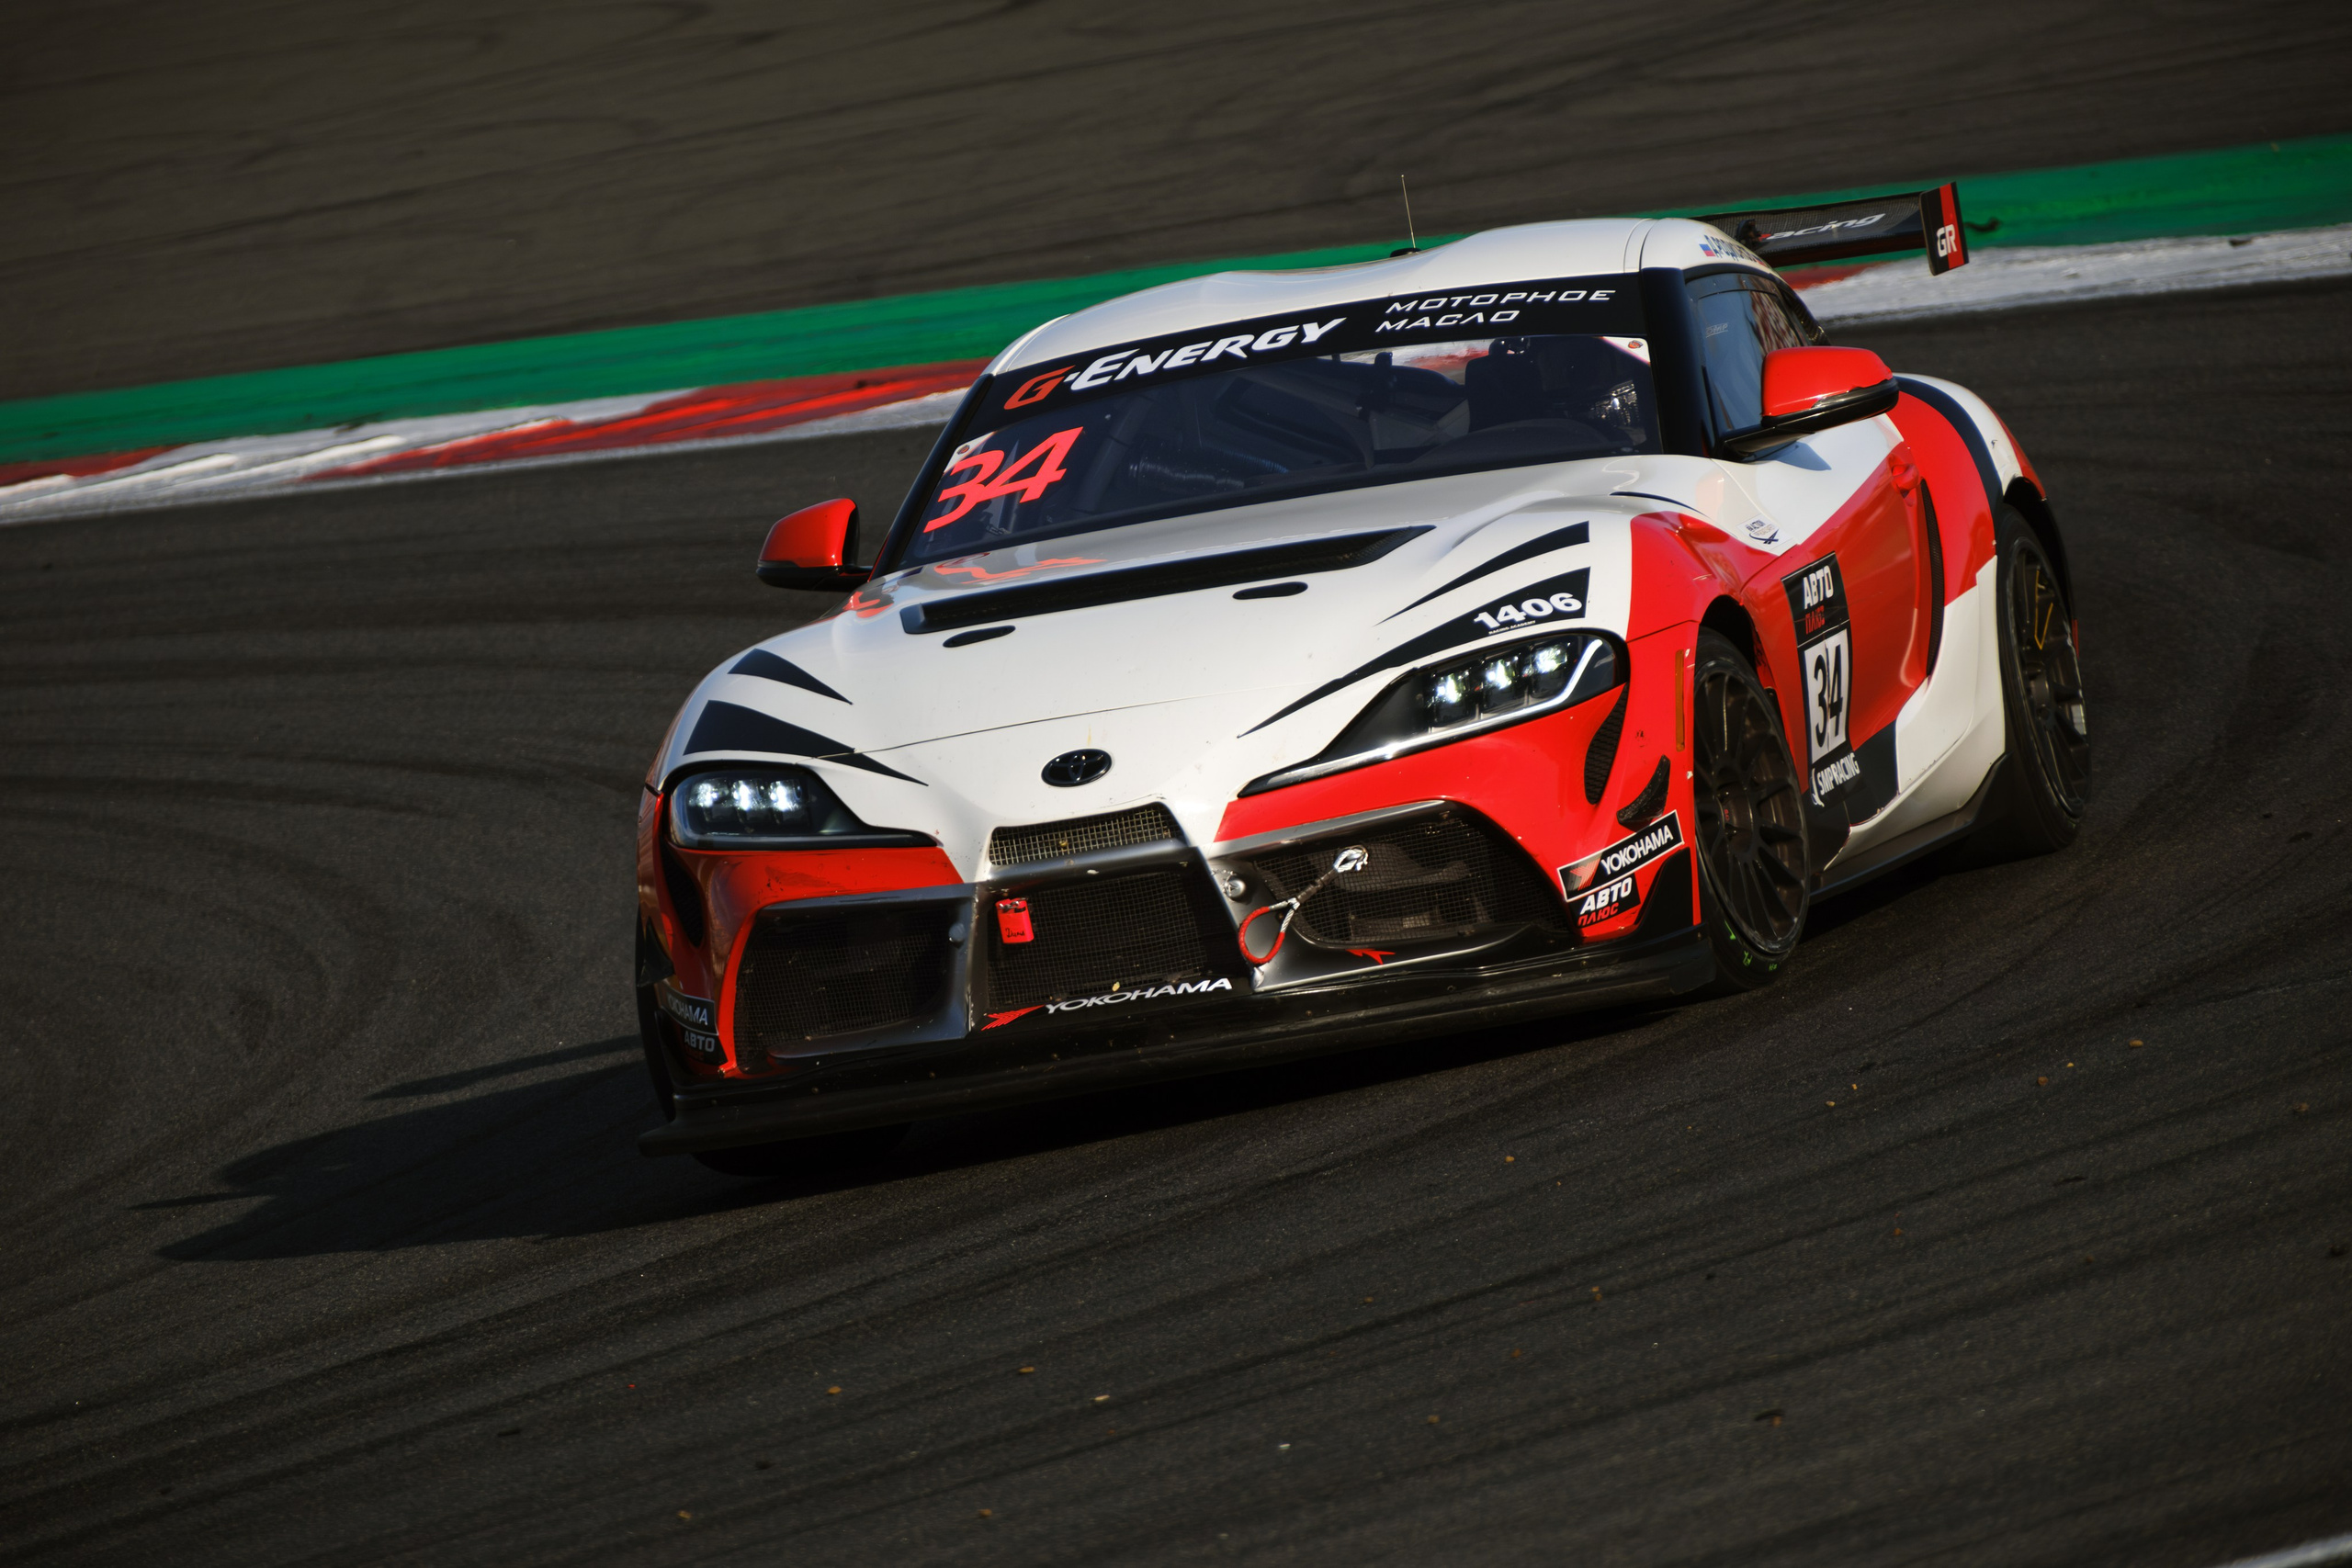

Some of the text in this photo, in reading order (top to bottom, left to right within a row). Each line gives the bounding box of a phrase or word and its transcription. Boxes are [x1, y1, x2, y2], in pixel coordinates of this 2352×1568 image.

[1758, 213, 1886, 242] acing
[1937, 223, 1959, 258] GR
[1385, 288, 1617, 314] МОТОРНОЕ
[1374, 309, 1521, 333] МАСЛО
[922, 425, 1084, 534] 34
[1802, 565, 1835, 610] АВТО
[1473, 592, 1583, 629] 1406
[1813, 643, 1843, 749] 34
[1600, 825, 1674, 875] YOKOHAMA
[1577, 902, 1620, 927] ПЛЮС
[1579, 877, 1633, 916] АВТО
[1045, 977, 1234, 1015] YOKOHAMA
